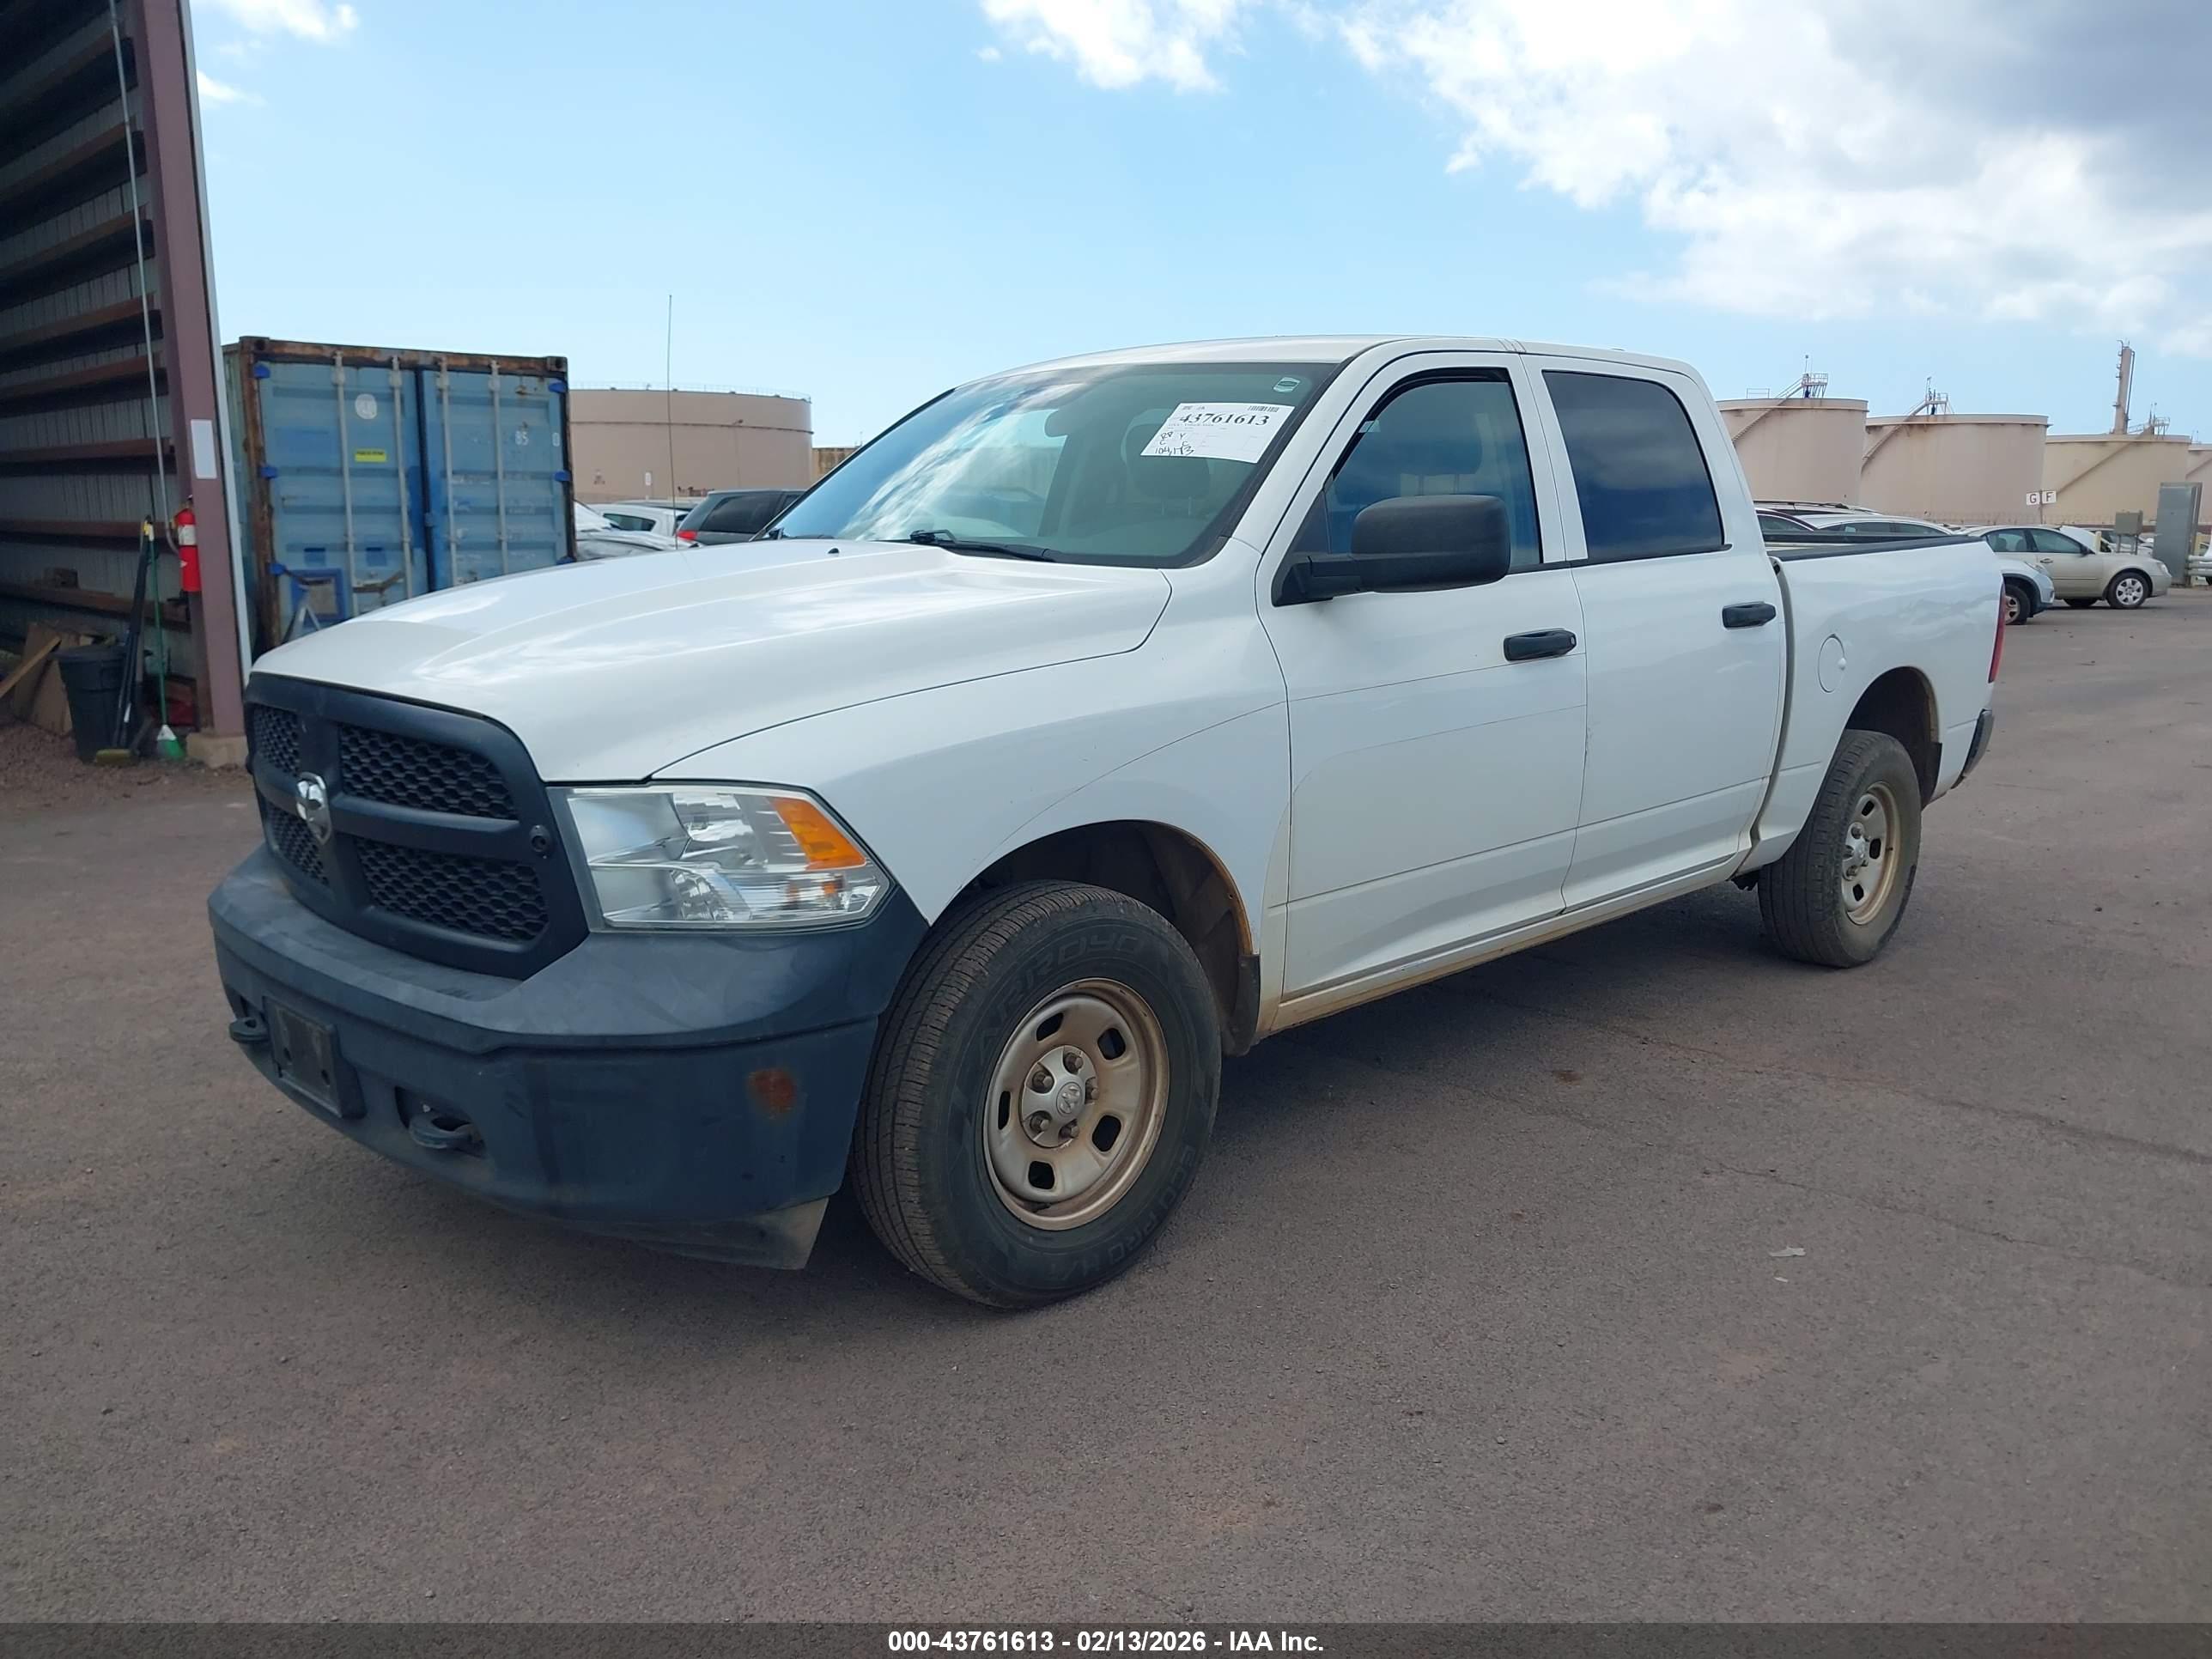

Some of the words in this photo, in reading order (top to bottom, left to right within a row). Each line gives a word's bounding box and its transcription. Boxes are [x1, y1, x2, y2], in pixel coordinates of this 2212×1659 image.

[1179, 413, 1270, 426] 43761613
[2029, 493, 2037, 503] G
[2046, 491, 2055, 501] F
